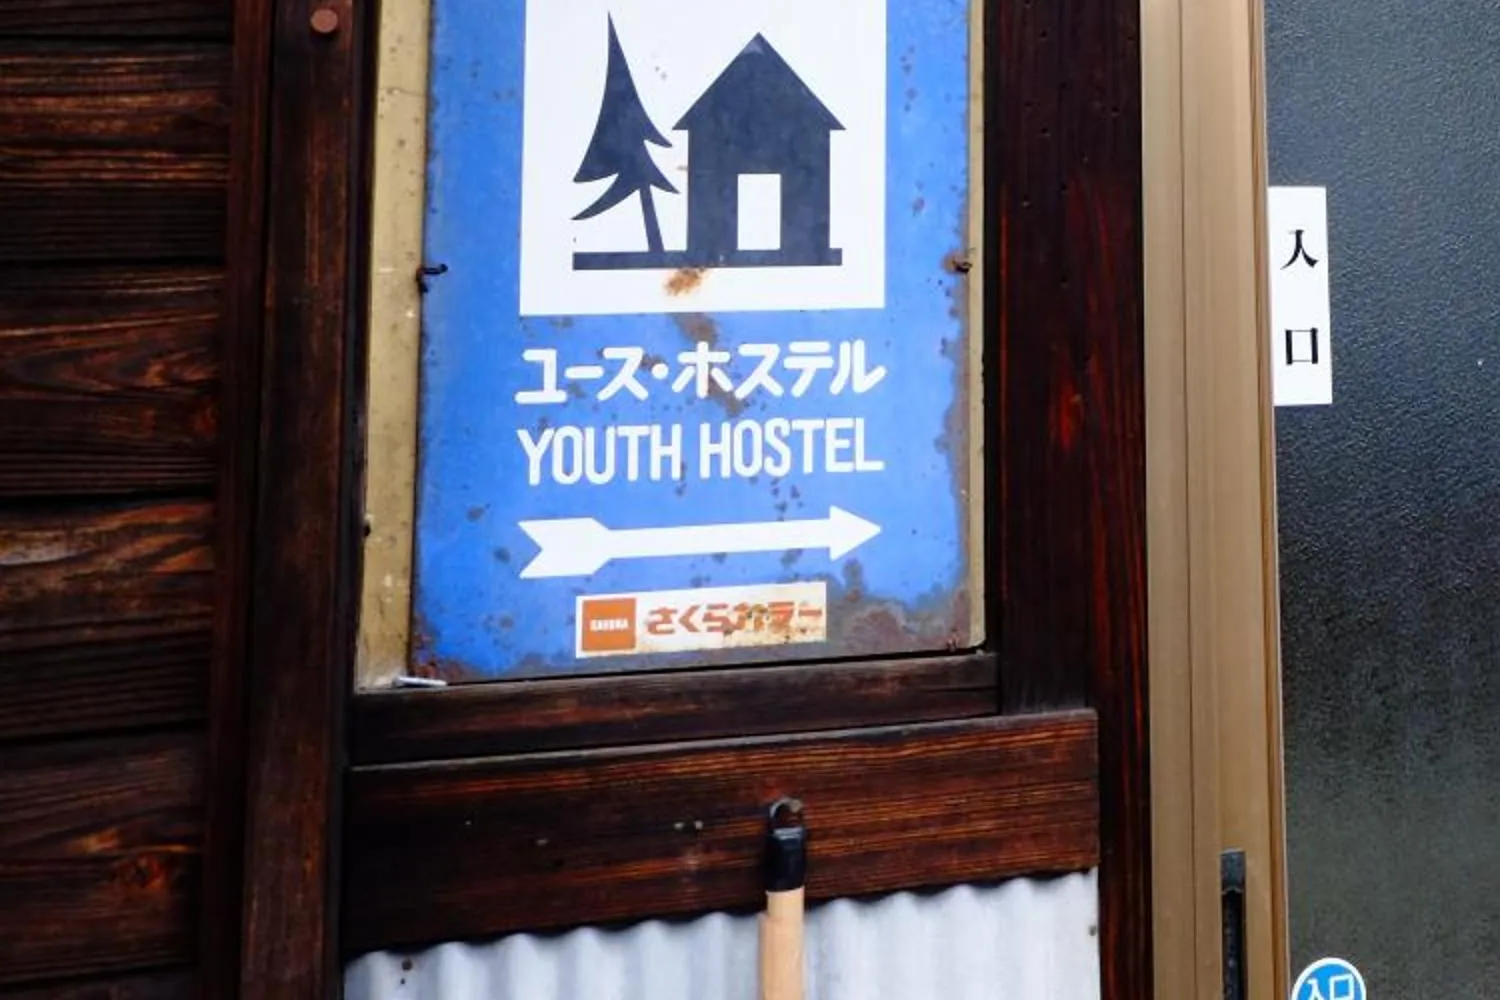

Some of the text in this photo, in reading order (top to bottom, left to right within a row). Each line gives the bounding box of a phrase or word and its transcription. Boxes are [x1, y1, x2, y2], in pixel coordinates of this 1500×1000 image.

[1280, 229, 1319, 366] 入口
[515, 339, 886, 404] ユース・ホステル
[517, 417, 886, 486] YOUTH HOSTEL
